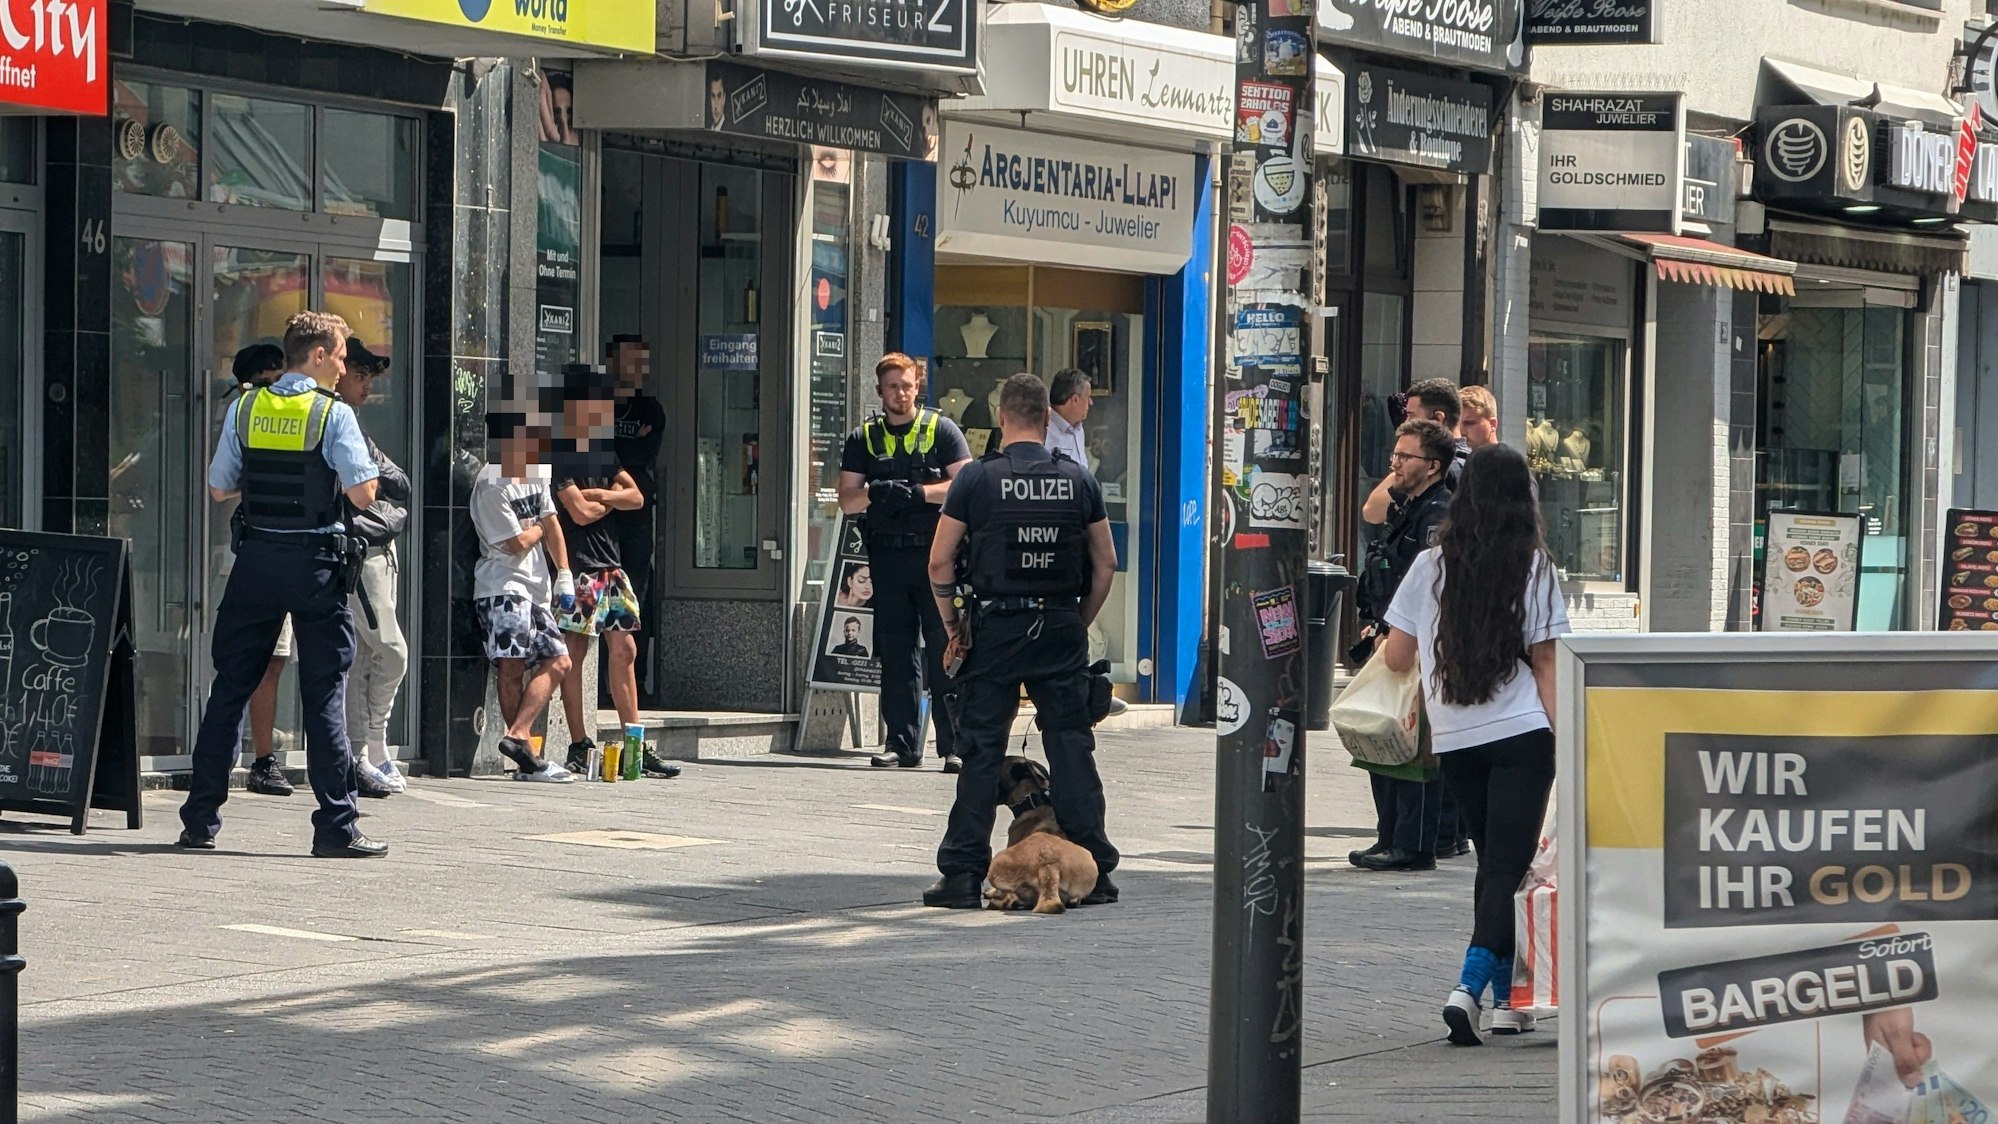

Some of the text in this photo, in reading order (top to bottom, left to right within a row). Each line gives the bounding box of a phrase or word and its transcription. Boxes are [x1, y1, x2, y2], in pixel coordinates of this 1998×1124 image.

[531, 22, 567, 35] Money Transfer
[828, 4, 923, 30] FRISEUR
[1531, 25, 1563, 34] ABEND
[1574, 25, 1639, 33] BRAUTMODEN
[1392, 17, 1492, 53] ABEND & BRAUTMODEN
[1063, 47, 1232, 125] UHREN Lennartz
[1387, 79, 1488, 139] Änderungsschneiderei
[1552, 99, 1644, 112] SHAHRAZAT
[1596, 113, 1657, 124] JUWELIER
[765, 115, 881, 149] HERZLICH WILLKOMMEN
[1409, 130, 1463, 163] & Boutique
[1891, 120, 1955, 195] DÖNER
[1550, 155, 1577, 167] IHR
[979, 144, 1177, 210] ARGJENTARIA-LLAPI
[1550, 172, 1666, 186] GOLDSCHMIED
[914, 214, 929, 238] 42
[1004, 199, 1079, 232] Kuyumcu
[1095, 209, 1160, 240] Juwelier
[82, 217, 106, 254] 46
[547, 249, 569, 262] Mit und
[539, 264, 576, 279] Ohne Termin
[1246, 313, 1285, 323] HELLO
[703, 352, 758, 363] freihalten
[709, 339, 757, 352] Eingang
[252, 415, 303, 435] POLIZEI
[1001, 478, 1074, 500] POLIZEI
[1018, 527, 1059, 543] NRW
[1021, 552, 1055, 569] DHF
[22, 664, 76, 693] Caffe
[1698, 750, 1808, 796] WIR
[1699, 808, 1926, 852] KAUFEN
[1699, 863, 1973, 909] IHR GOLD
[1858, 933, 1934, 960] Sofort
[1681, 958, 1925, 1031] BARGELD
